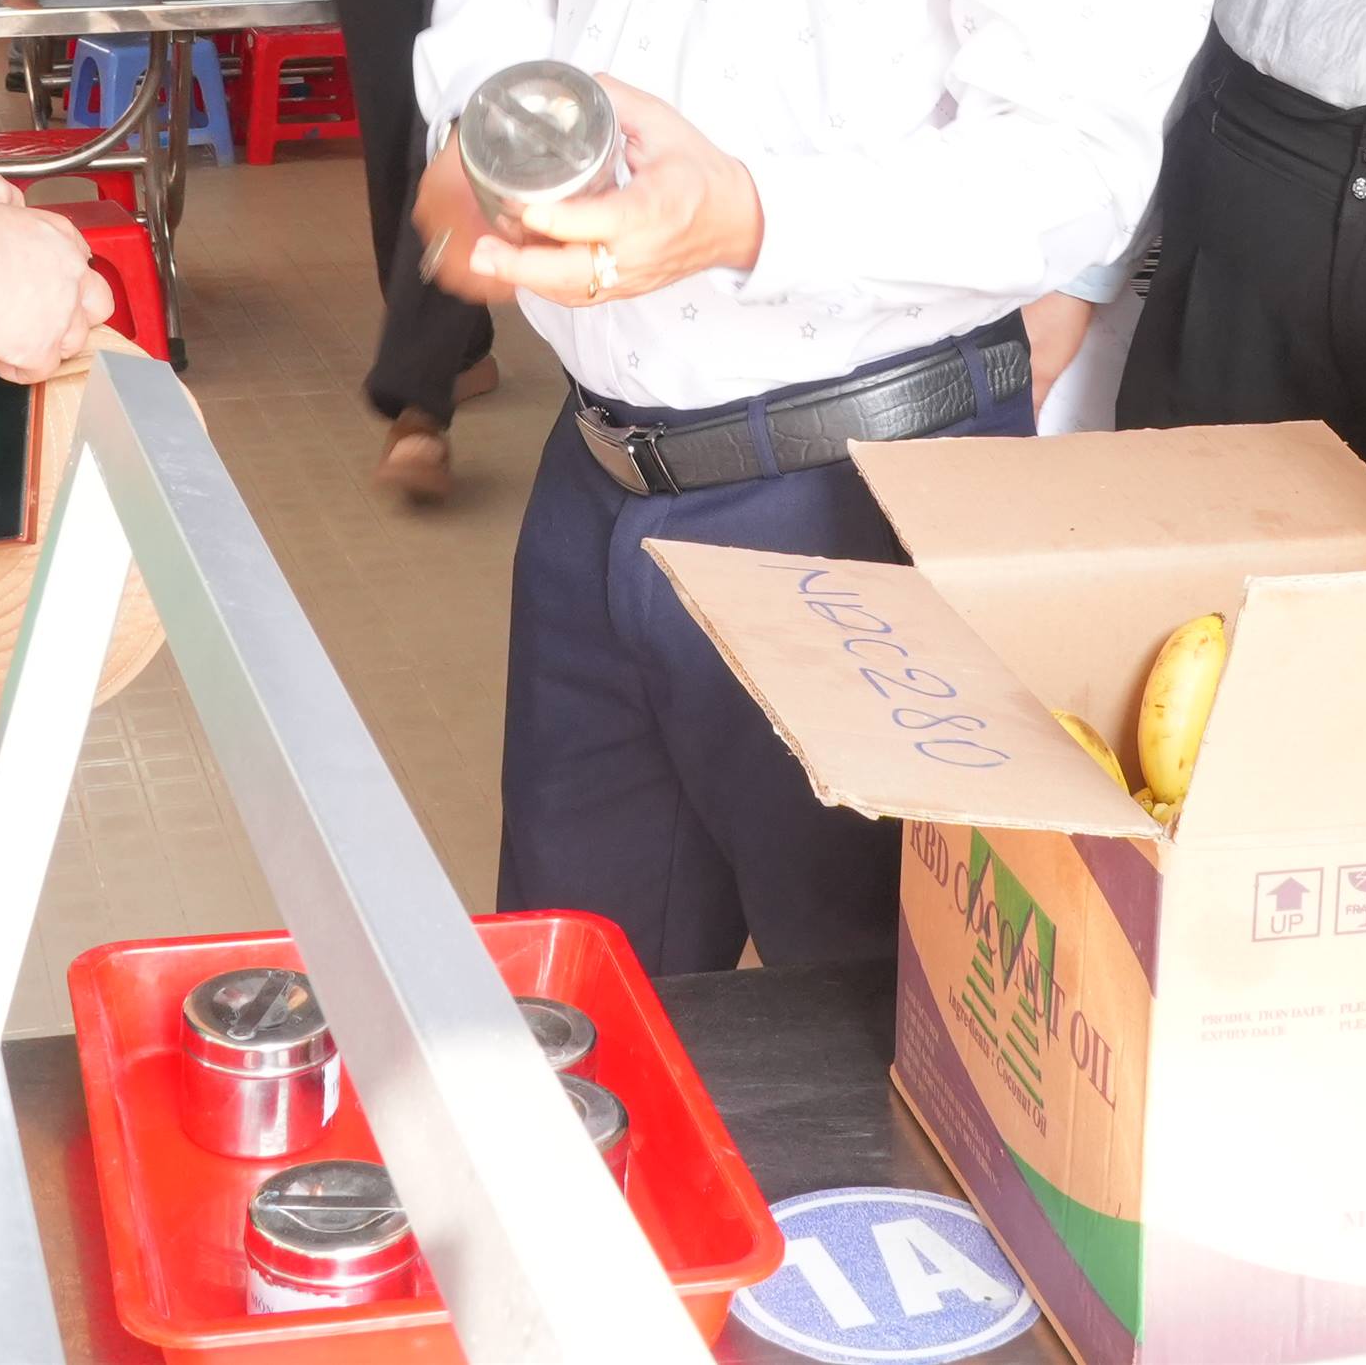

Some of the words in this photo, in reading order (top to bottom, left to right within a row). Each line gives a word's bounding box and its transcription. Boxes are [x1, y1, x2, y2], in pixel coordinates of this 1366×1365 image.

[909, 821, 950, 888] RBD
[953, 866, 1066, 1042] COCONUT
[1070, 1009, 1117, 1114] OIL
[1270, 913, 1304, 935] UP
[996, 1048, 1031, 1120] Coconut
[1031, 1106, 1048, 1139] Oil
[788, 1219, 996, 1329] 1A
